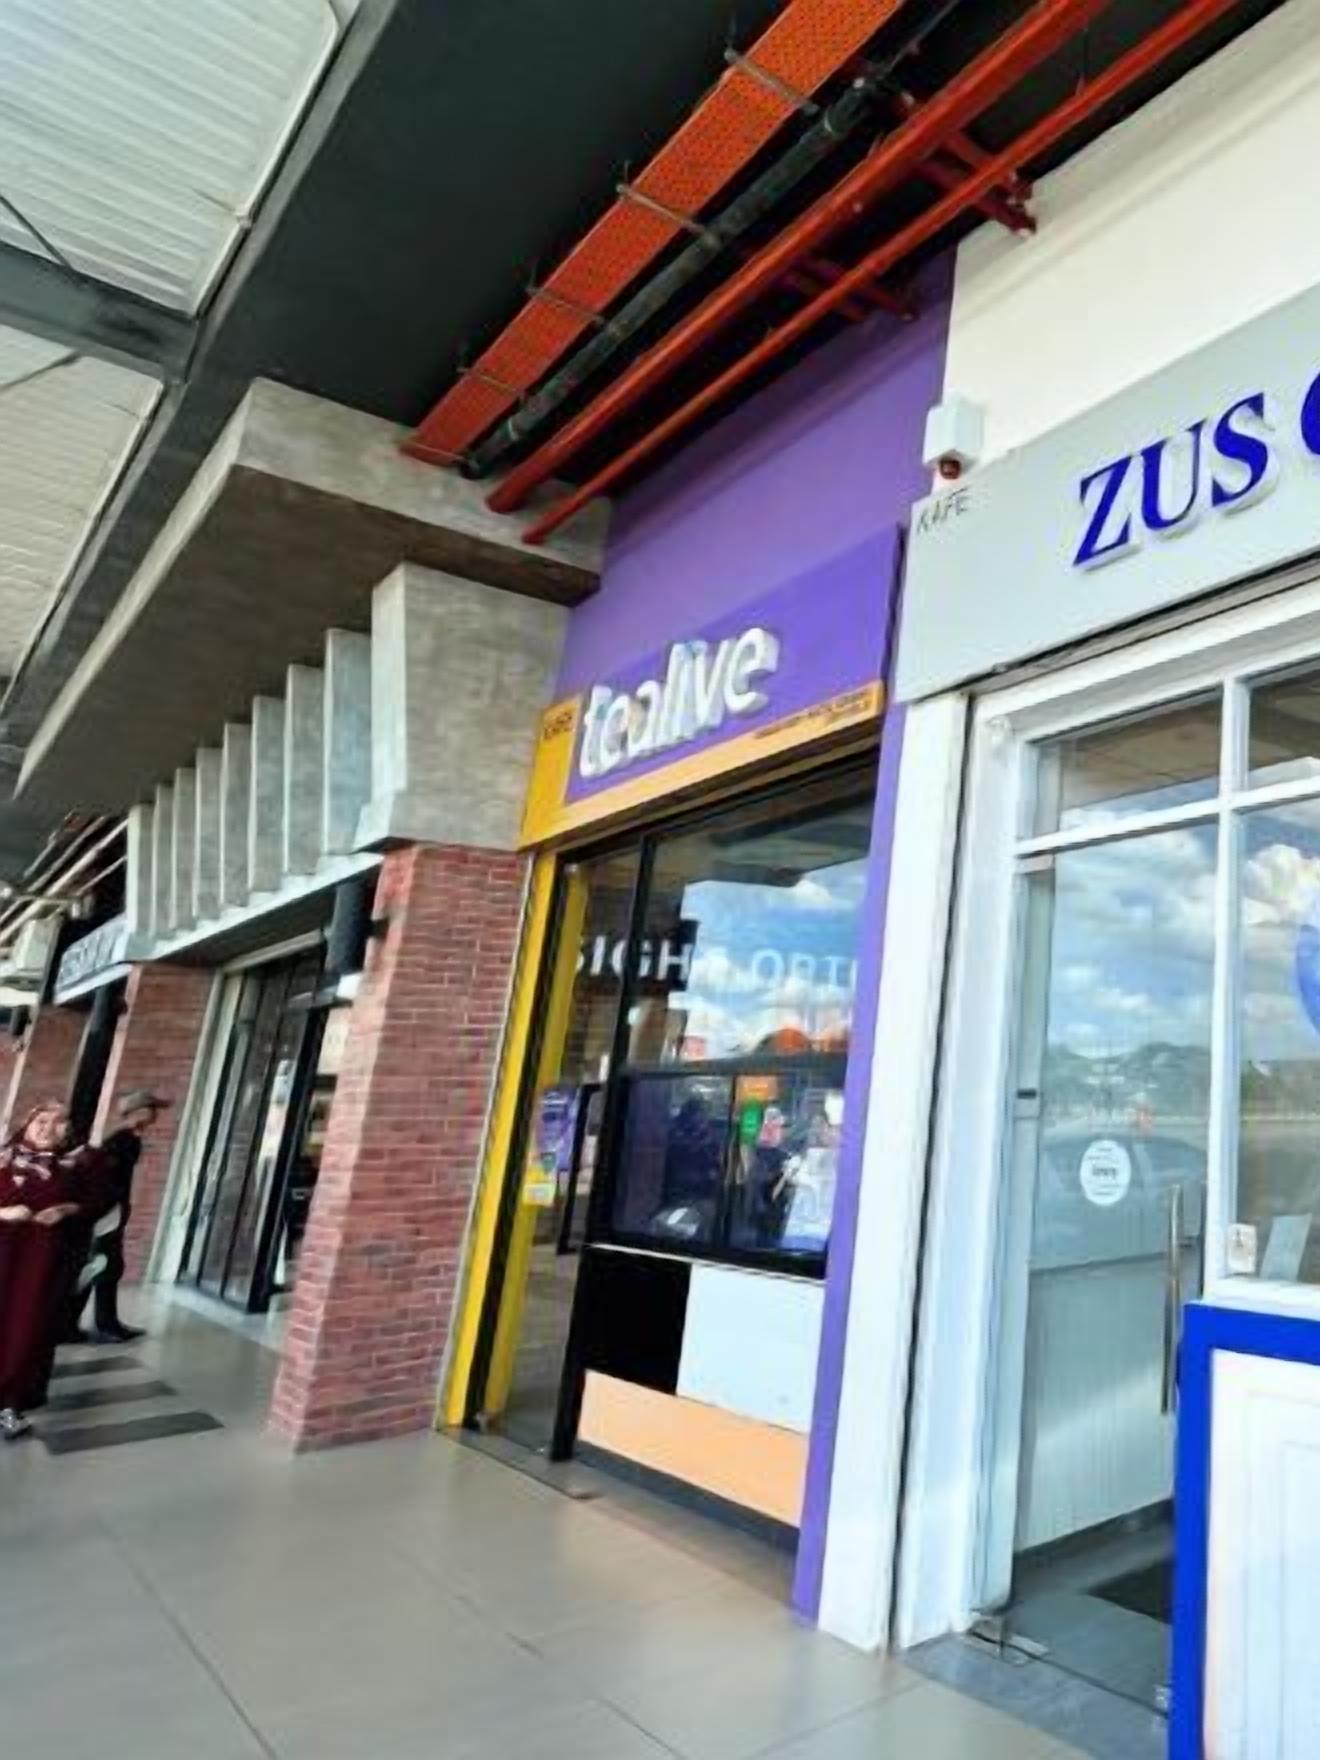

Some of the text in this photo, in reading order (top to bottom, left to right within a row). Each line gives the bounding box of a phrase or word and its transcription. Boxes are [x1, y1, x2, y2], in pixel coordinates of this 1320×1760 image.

[917, 486, 970, 534] KAFE
[1073, 392, 1273, 568] ZUS
[580, 627, 780, 778] tealive
